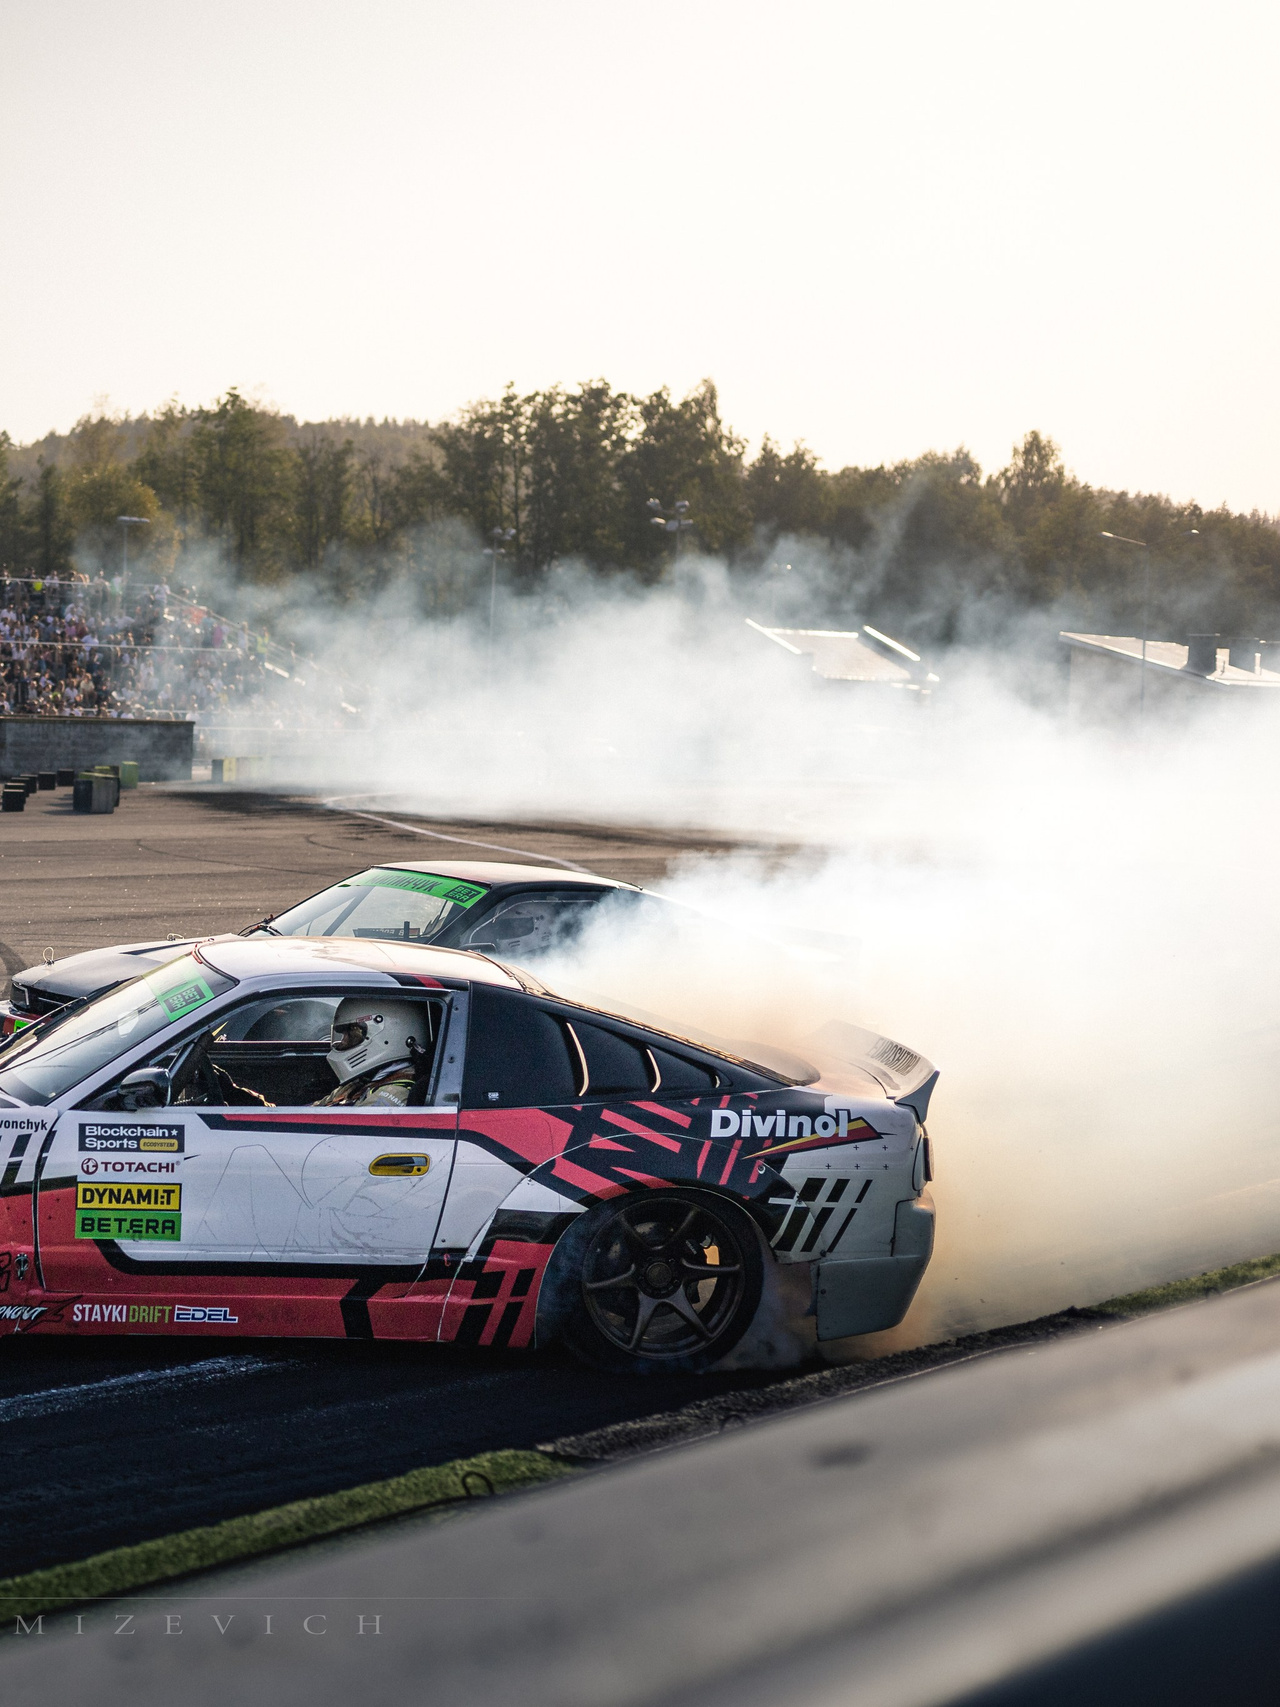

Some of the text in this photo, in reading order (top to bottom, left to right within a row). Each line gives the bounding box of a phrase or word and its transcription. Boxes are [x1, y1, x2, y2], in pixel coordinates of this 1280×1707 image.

[85, 1125, 169, 1137] Blockchain
[710, 1109, 849, 1138] Divinol
[85, 1137, 138, 1150] Sports
[101, 1161, 175, 1173] TOTACHI
[81, 1217, 175, 1235] BETERA
[174, 1305, 238, 1323] EDEL
